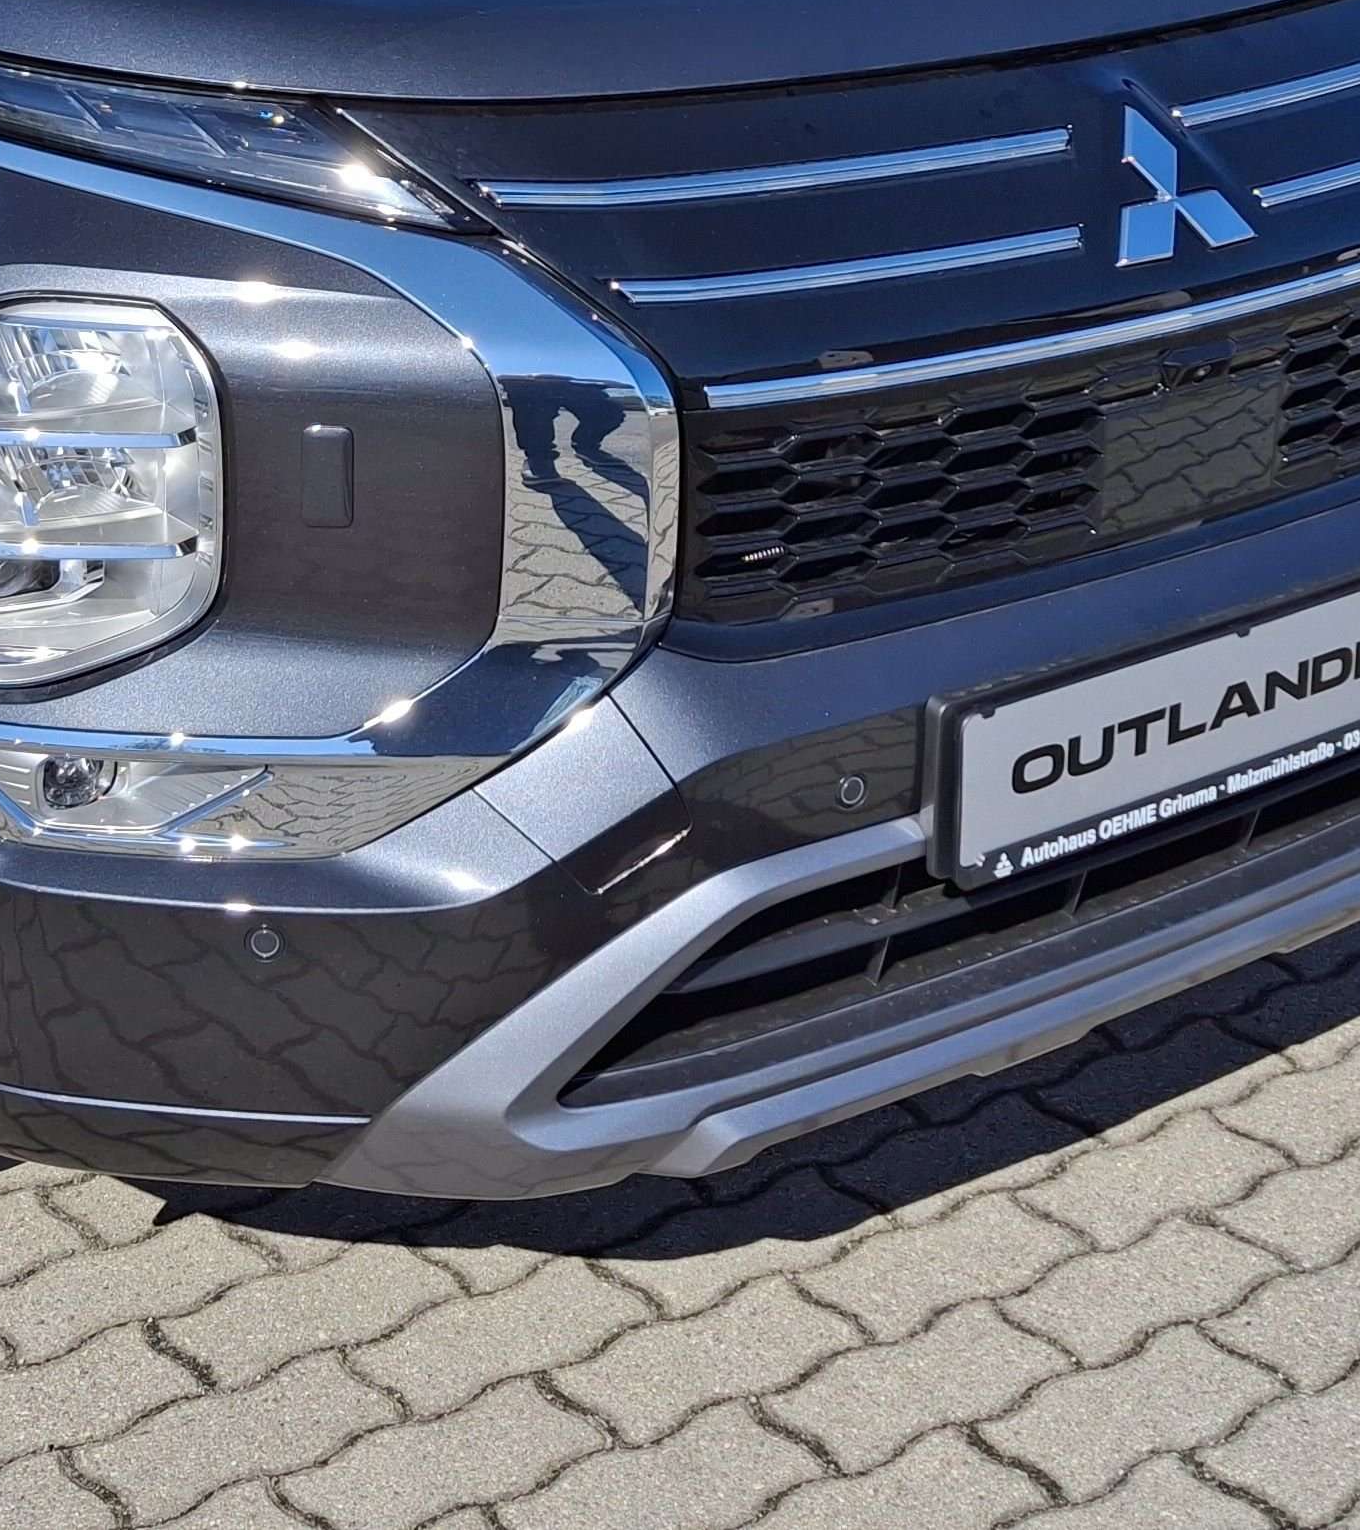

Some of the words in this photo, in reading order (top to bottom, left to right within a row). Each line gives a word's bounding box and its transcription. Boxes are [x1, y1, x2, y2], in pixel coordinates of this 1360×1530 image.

[1020, 828, 1097, 867] Autohaus
[1098, 803, 1157, 840] OEHME
[1159, 784, 1218, 818] Grimma
[1227, 741, 1335, 794] Malzmühlstraße
